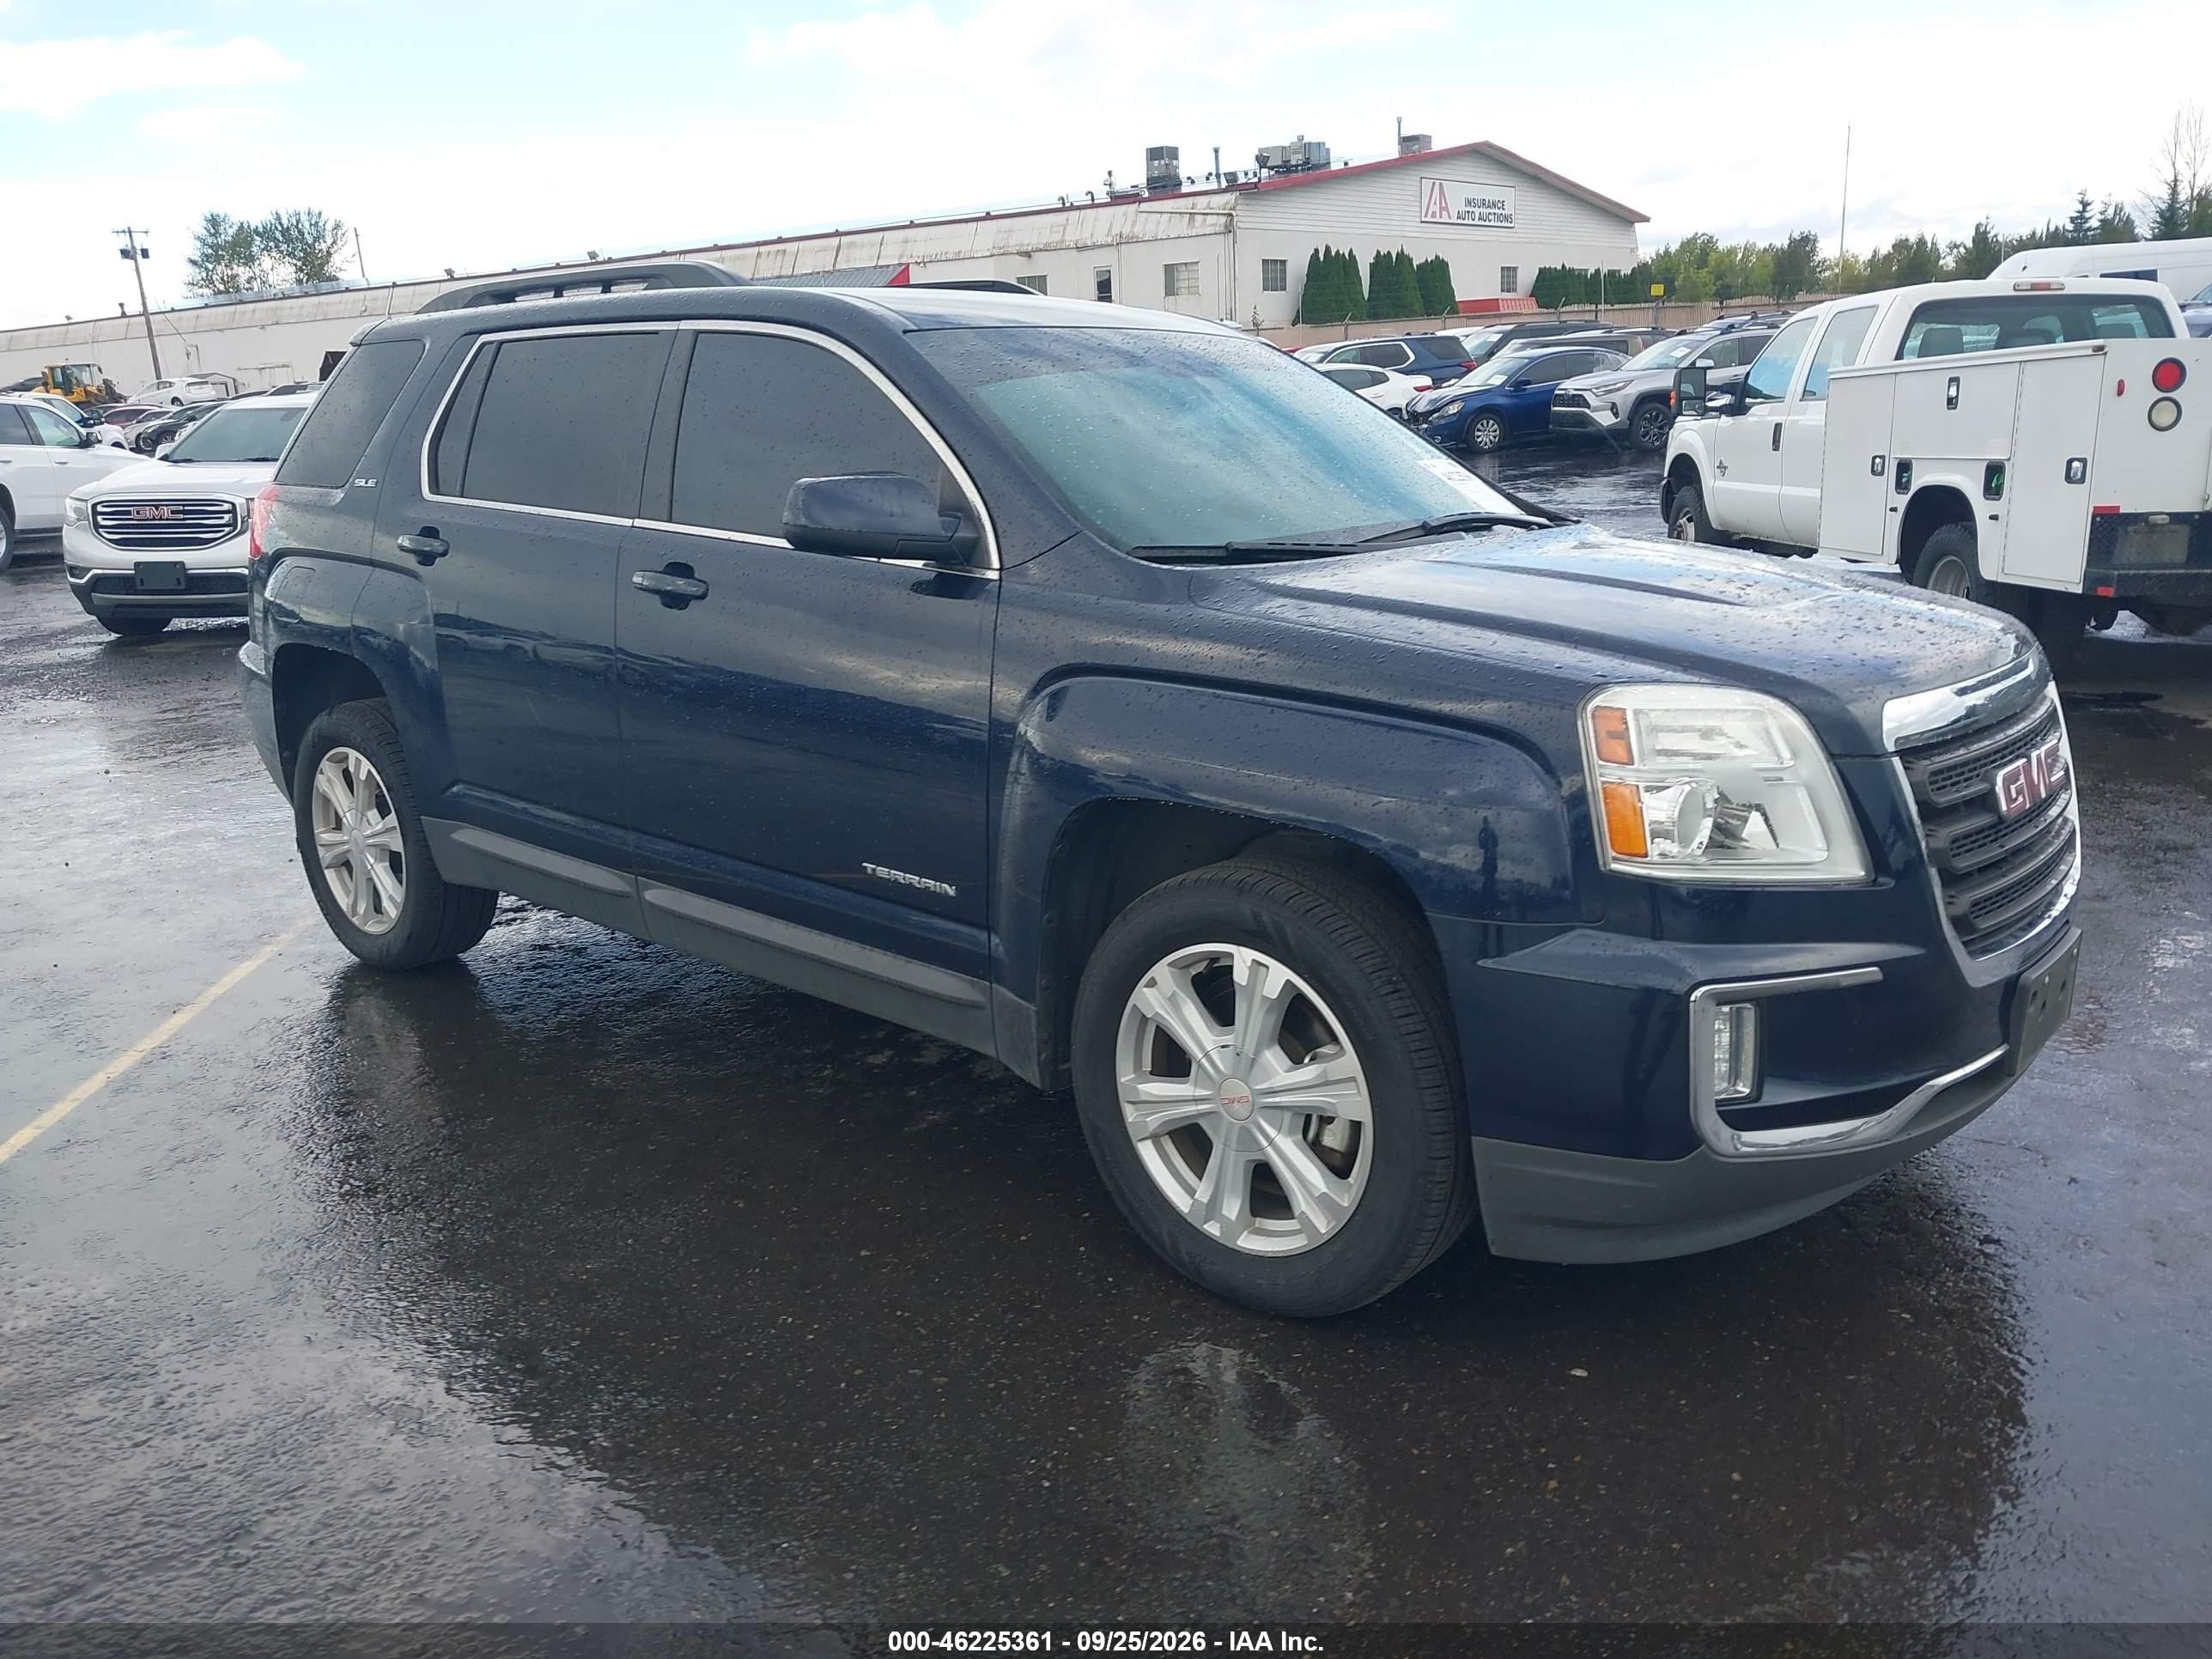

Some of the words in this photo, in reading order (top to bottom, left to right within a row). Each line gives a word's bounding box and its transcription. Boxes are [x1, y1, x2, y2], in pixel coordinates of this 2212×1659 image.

[1464, 196, 1506, 210] INSURANCE
[1456, 210, 1476, 222] AUTO
[1478, 211, 1513, 224] AUCTIONS
[353, 478, 378, 487] SLE
[131, 506, 184, 520] GMC
[1996, 739, 2067, 817] GMC
[861, 861, 957, 897] TERRAIN
